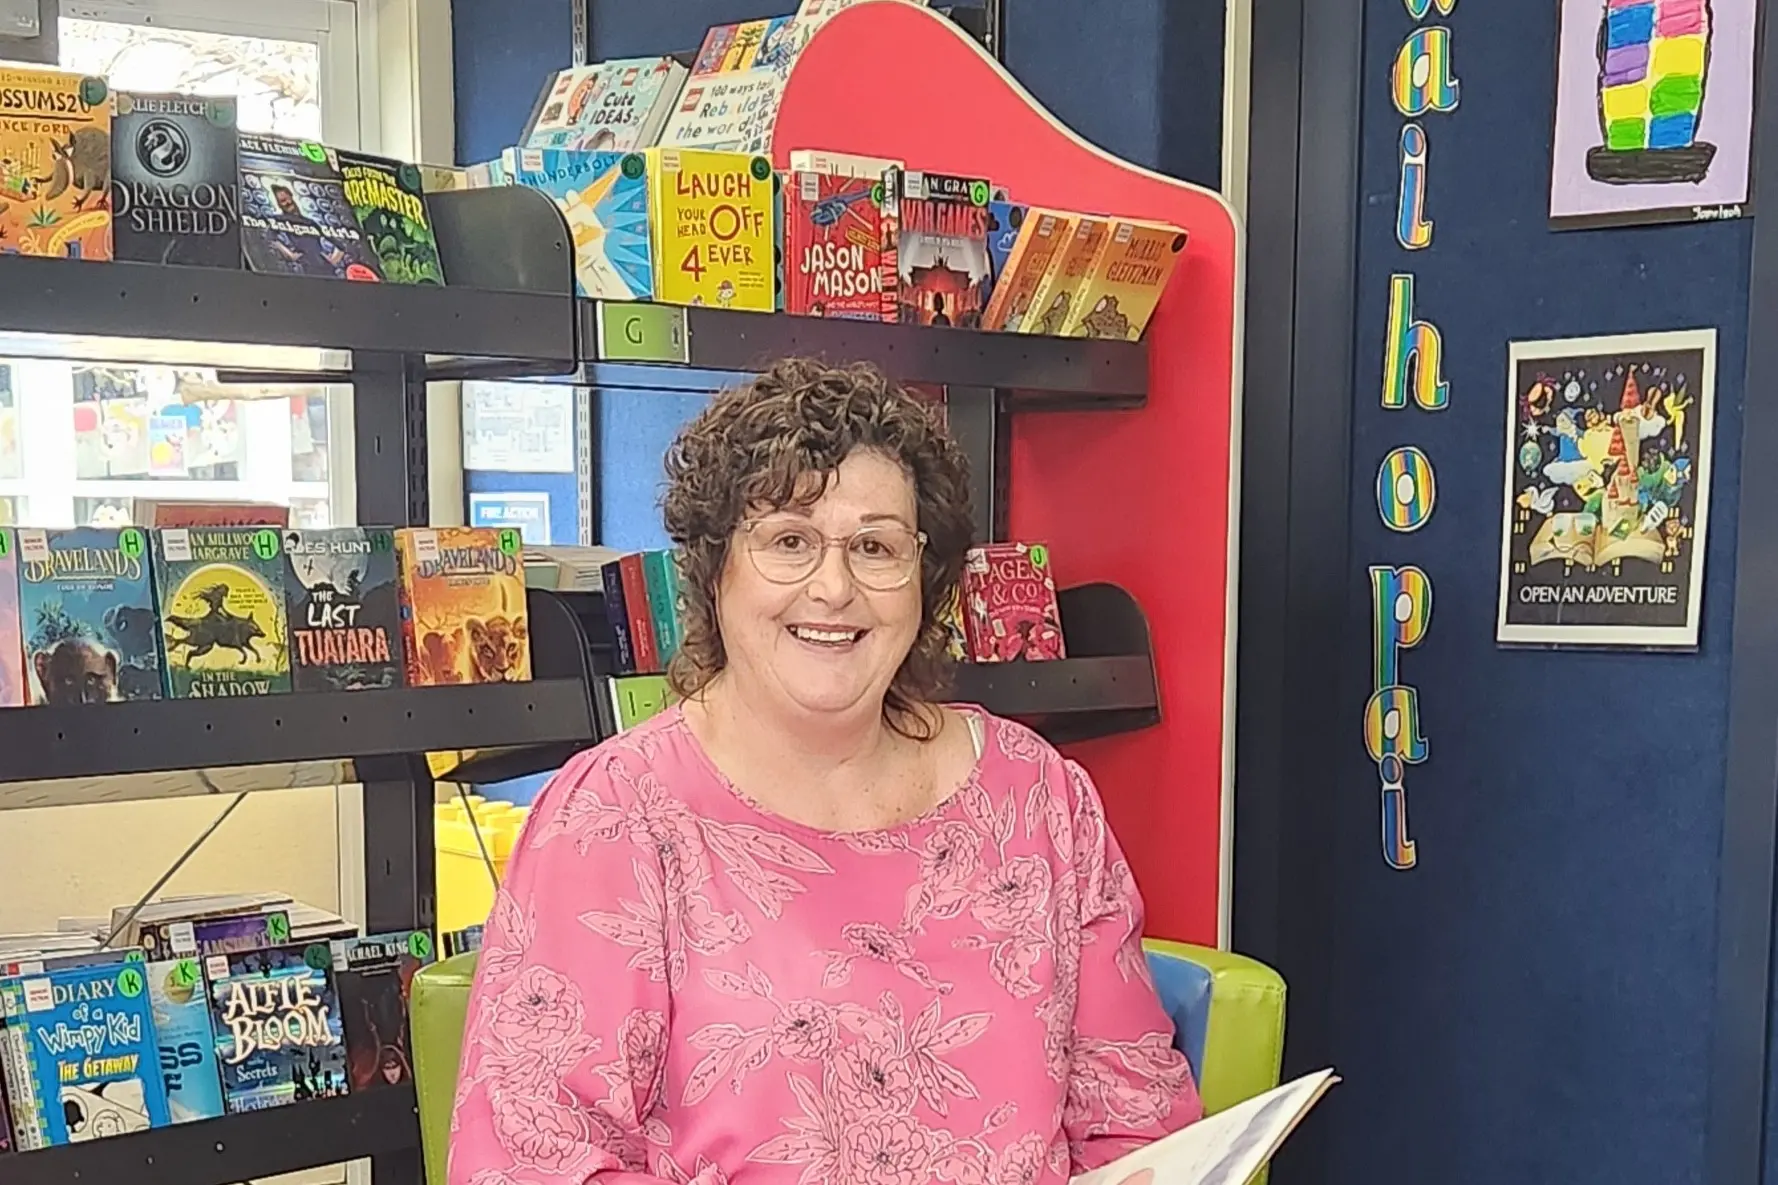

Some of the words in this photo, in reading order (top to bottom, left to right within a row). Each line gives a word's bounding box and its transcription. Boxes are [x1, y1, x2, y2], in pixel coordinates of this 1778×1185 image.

[160, 101, 207, 115] FLETCH
[603, 91, 636, 107] Cute
[699, 95, 760, 118] Rebild
[589, 108, 634, 125] IDEAS
[707, 115, 751, 135] word
[677, 170, 751, 199] LAUGH
[975, 184, 984, 203] G
[111, 180, 238, 222] DRAGON
[132, 208, 228, 234] SHIELD
[242, 214, 266, 228] The
[270, 217, 320, 236] Enigma
[677, 207, 706, 221] YOUR
[709, 204, 764, 241] OFF
[901, 199, 934, 233] WAR
[937, 203, 987, 240] GAMES
[677, 224, 706, 238] HEAD
[681, 245, 707, 282] 4
[708, 245, 754, 265] EVER
[801, 242, 864, 274] JASON
[813, 266, 882, 298] MASON
[625, 318, 642, 344] G
[1364, 0, 1460, 872] aihopai
[124, 533, 140, 553] H
[258, 534, 273, 556] H
[501, 531, 514, 550] H
[1033, 548, 1042, 564] J
[312, 590, 334, 602] THE
[992, 583, 1009, 606] &
[1520, 586, 1559, 603] OPEN
[1561, 586, 1585, 602] AN
[1587, 586, 1678, 603] ADVENTURE
[307, 604, 361, 628] LAST
[294, 628, 391, 667] TUATARA
[202, 673, 214, 682] IN
[216, 671, 237, 682] THE
[188, 680, 271, 698] SHADOW
[270, 917, 285, 939] K
[414, 934, 427, 956] K
[124, 973, 140, 994] K
[180, 962, 196, 983] K
[51, 977, 117, 1005] DIARY
[222, 974, 320, 1024] ALFIE
[72, 1003, 89, 1021] of
[92, 1008, 104, 1020] a
[38, 1022, 106, 1055] Wimpy
[106, 1012, 141, 1046] Kid
[225, 1006, 335, 1065] BLOOM
[58, 1060, 79, 1082] THE
[83, 1054, 140, 1078] GETAWAY
[236, 1060, 278, 1083] Secrets
